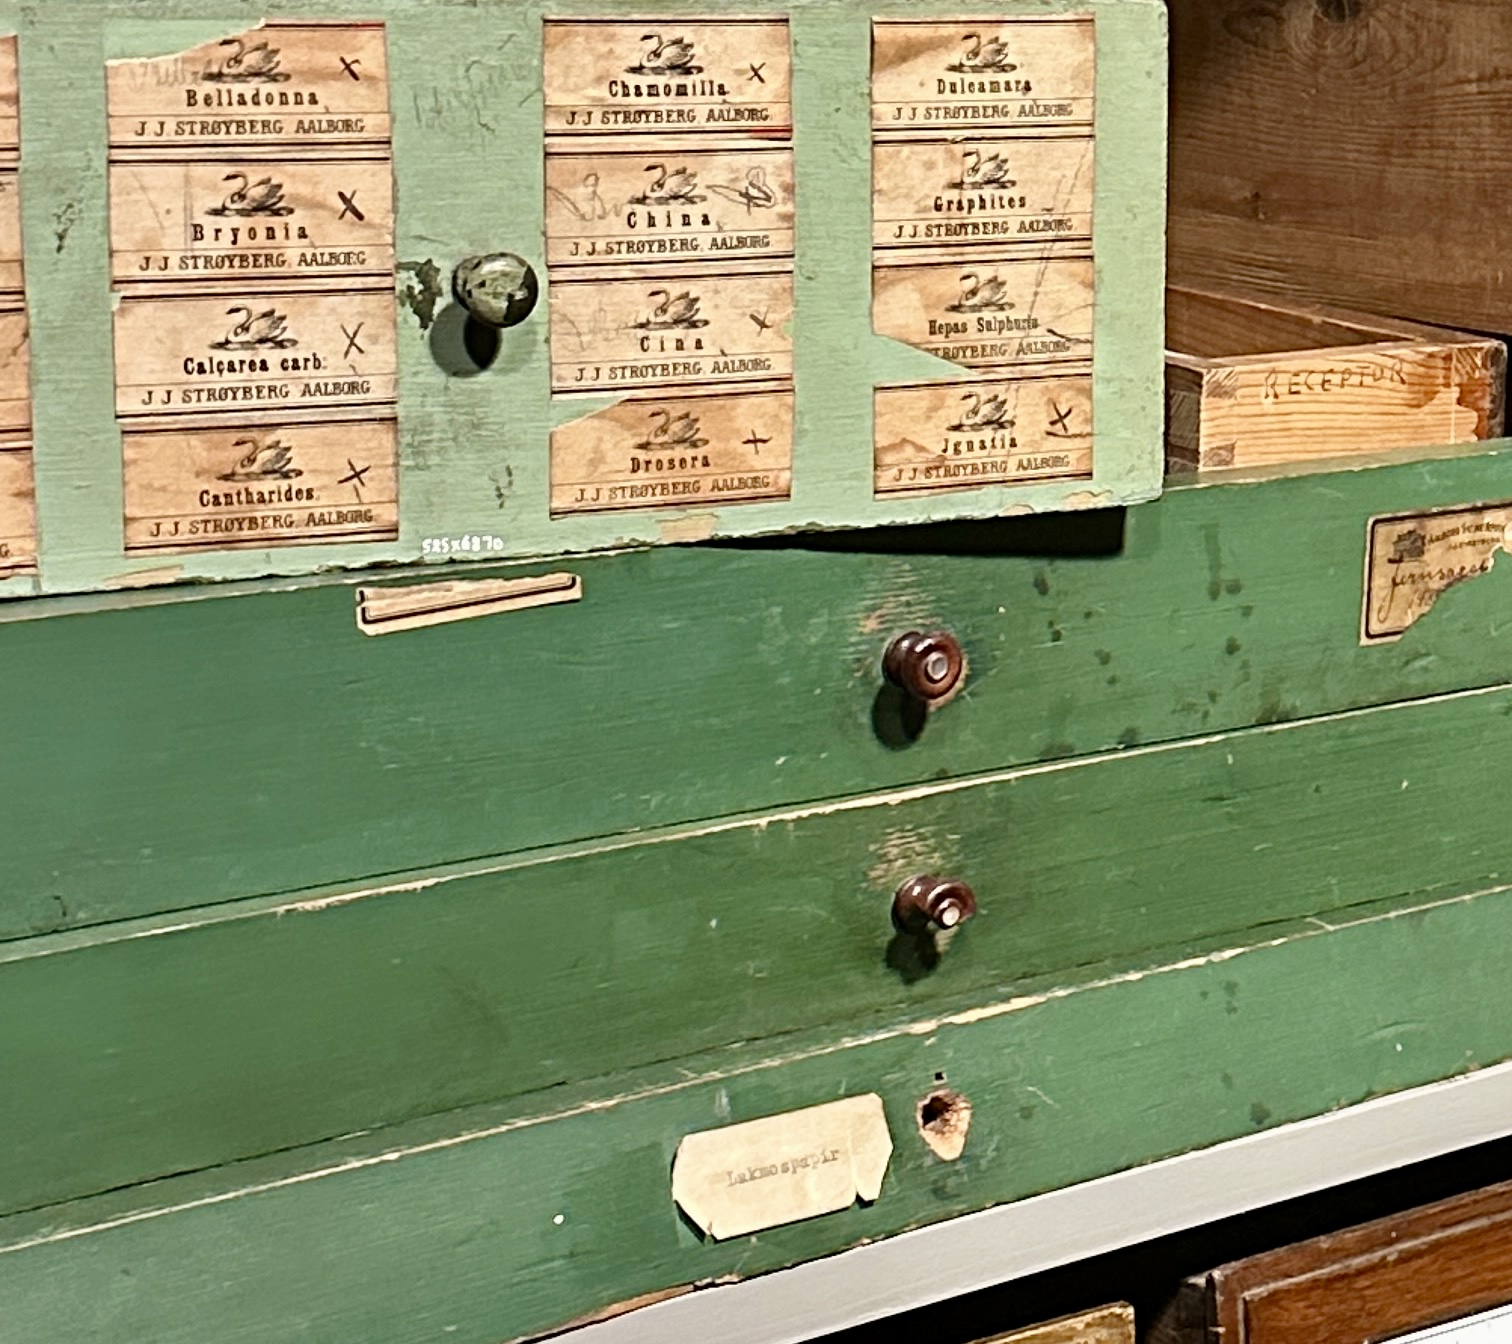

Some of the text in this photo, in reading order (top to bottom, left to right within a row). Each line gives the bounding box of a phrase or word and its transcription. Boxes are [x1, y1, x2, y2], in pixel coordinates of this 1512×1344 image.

[937, 78, 1032, 96] Dulcamara
[186, 89, 319, 107] Belladonna
[706, 107, 770, 123] AALBORG
[175, 120, 284, 135] STRØYBERG
[295, 119, 365, 134] AALBORG
[934, 195, 1026, 214] Graphites
[627, 211, 711, 229] China
[191, 223, 309, 245] Bryonia
[708, 235, 770, 250] AALBORG
[640, 335, 704, 353] Cina
[711, 358, 772, 373] AALBORG
[181, 384, 291, 404] STRØYBERG
[300, 380, 371, 397] AALBORG
[630, 455, 710, 473] Drosera
[710, 475, 770, 492] AALBORG
[305, 509, 374, 526] AALBORG
